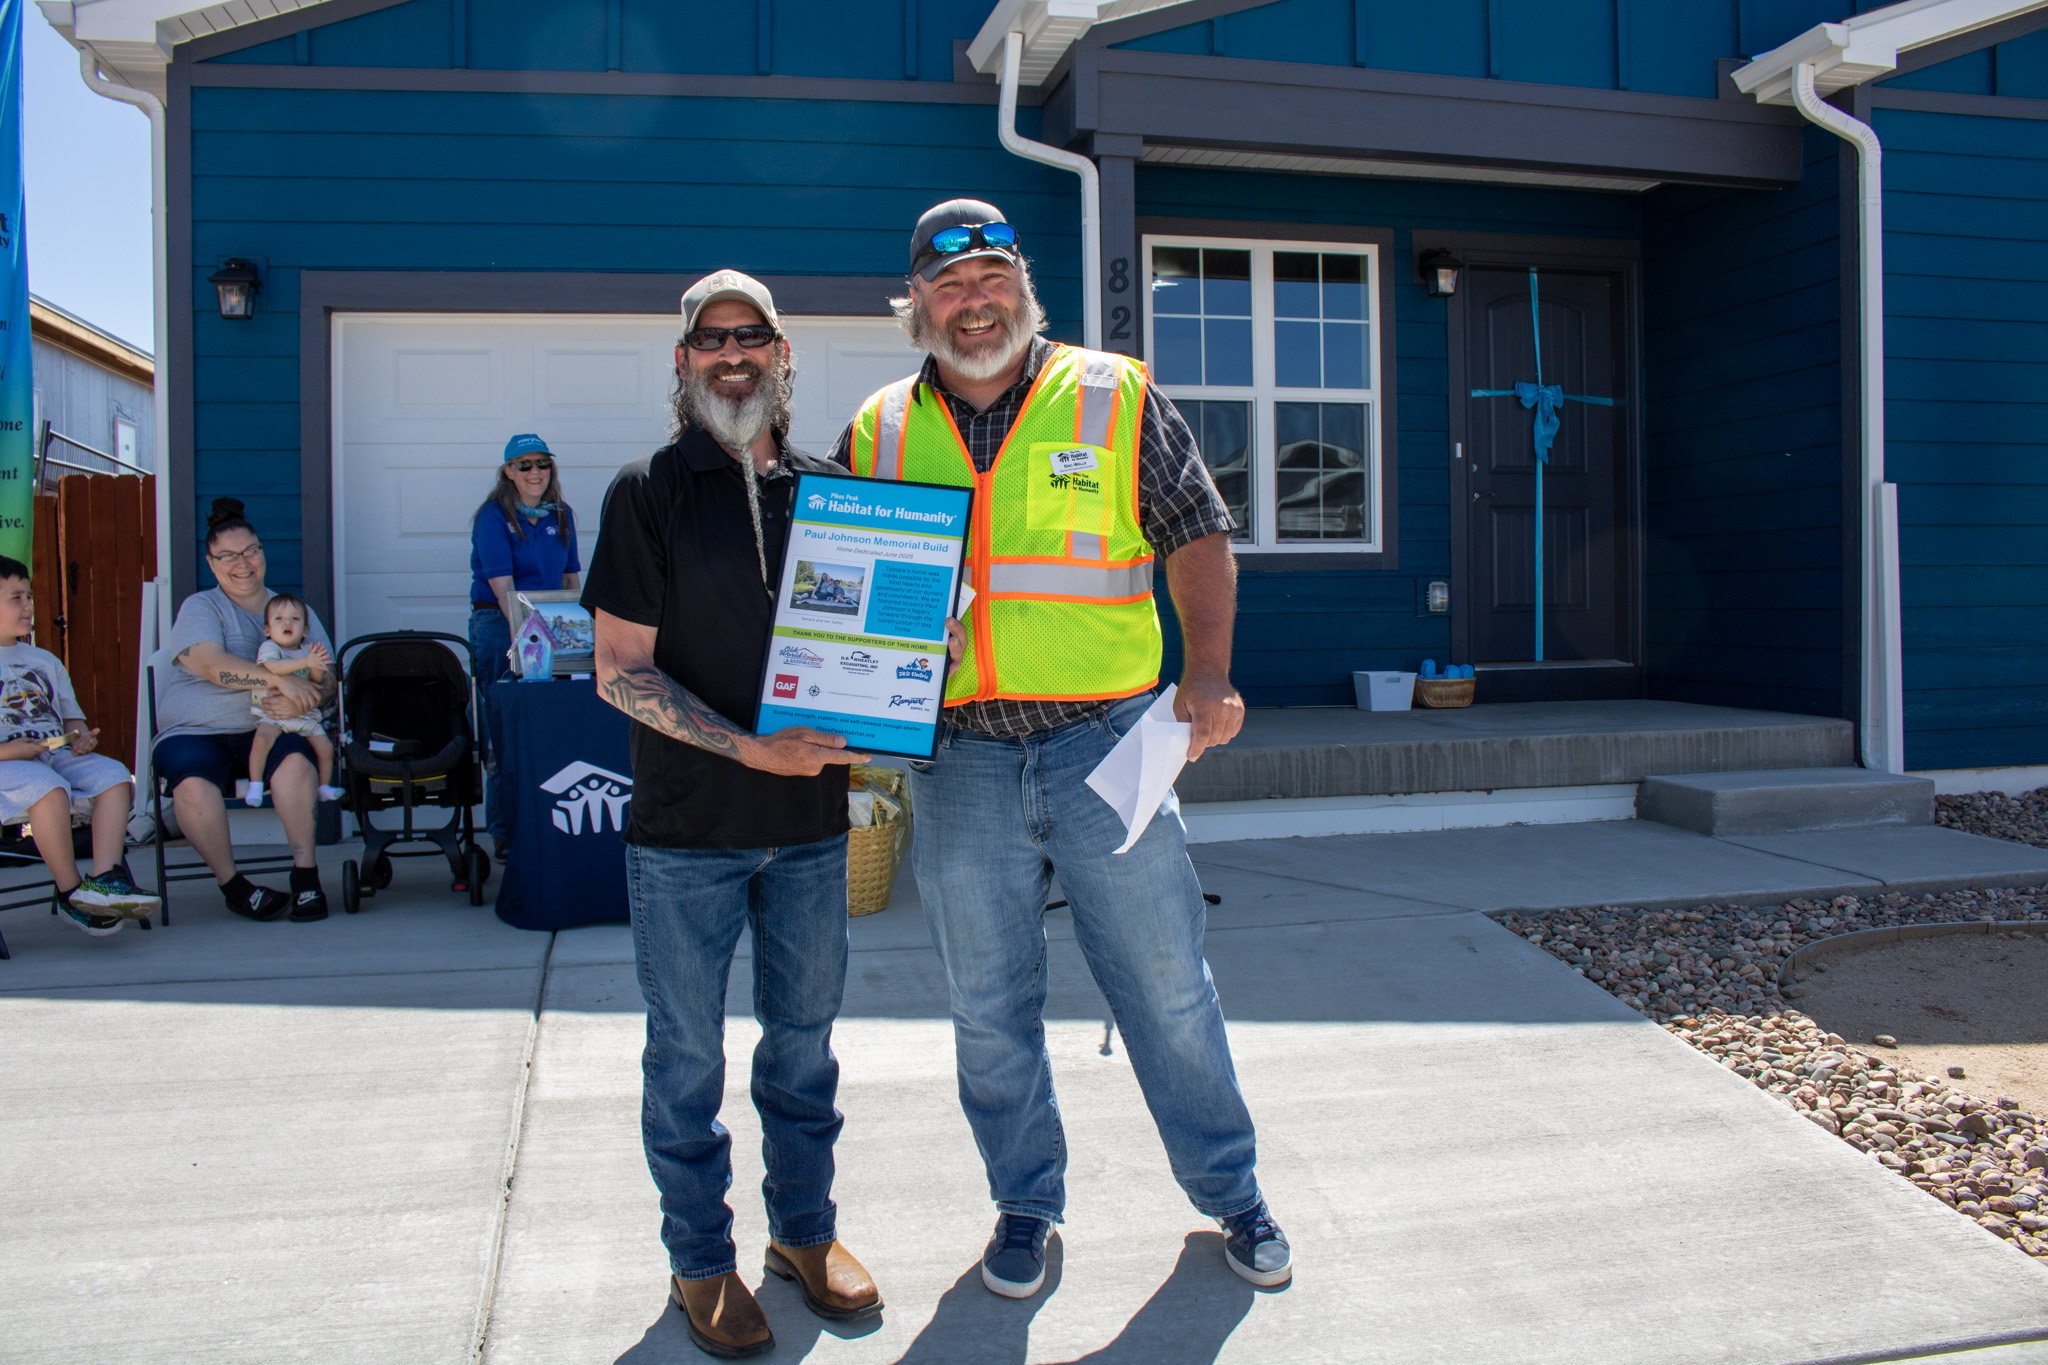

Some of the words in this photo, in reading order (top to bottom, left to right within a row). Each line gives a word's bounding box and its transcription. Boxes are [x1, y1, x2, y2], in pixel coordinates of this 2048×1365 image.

[707, 274, 745, 293] CAT
[1073, 477, 1099, 489] Habitat
[828, 500, 872, 516] Habitat
[875, 505, 893, 518] for
[895, 507, 954, 526] Humanity
[804, 529, 827, 539] Paul
[828, 532, 872, 545] Johnson
[873, 537, 920, 550] Memorial
[923, 542, 949, 553] Build
[854, 548, 883, 556] Dedicated
[875, 585, 905, 593] generosity
[901, 613, 922, 621] through
[848, 636, 886, 646] SUPPORTERS
[776, 681, 796, 691] GAF
[773, 709, 794, 717] Building
